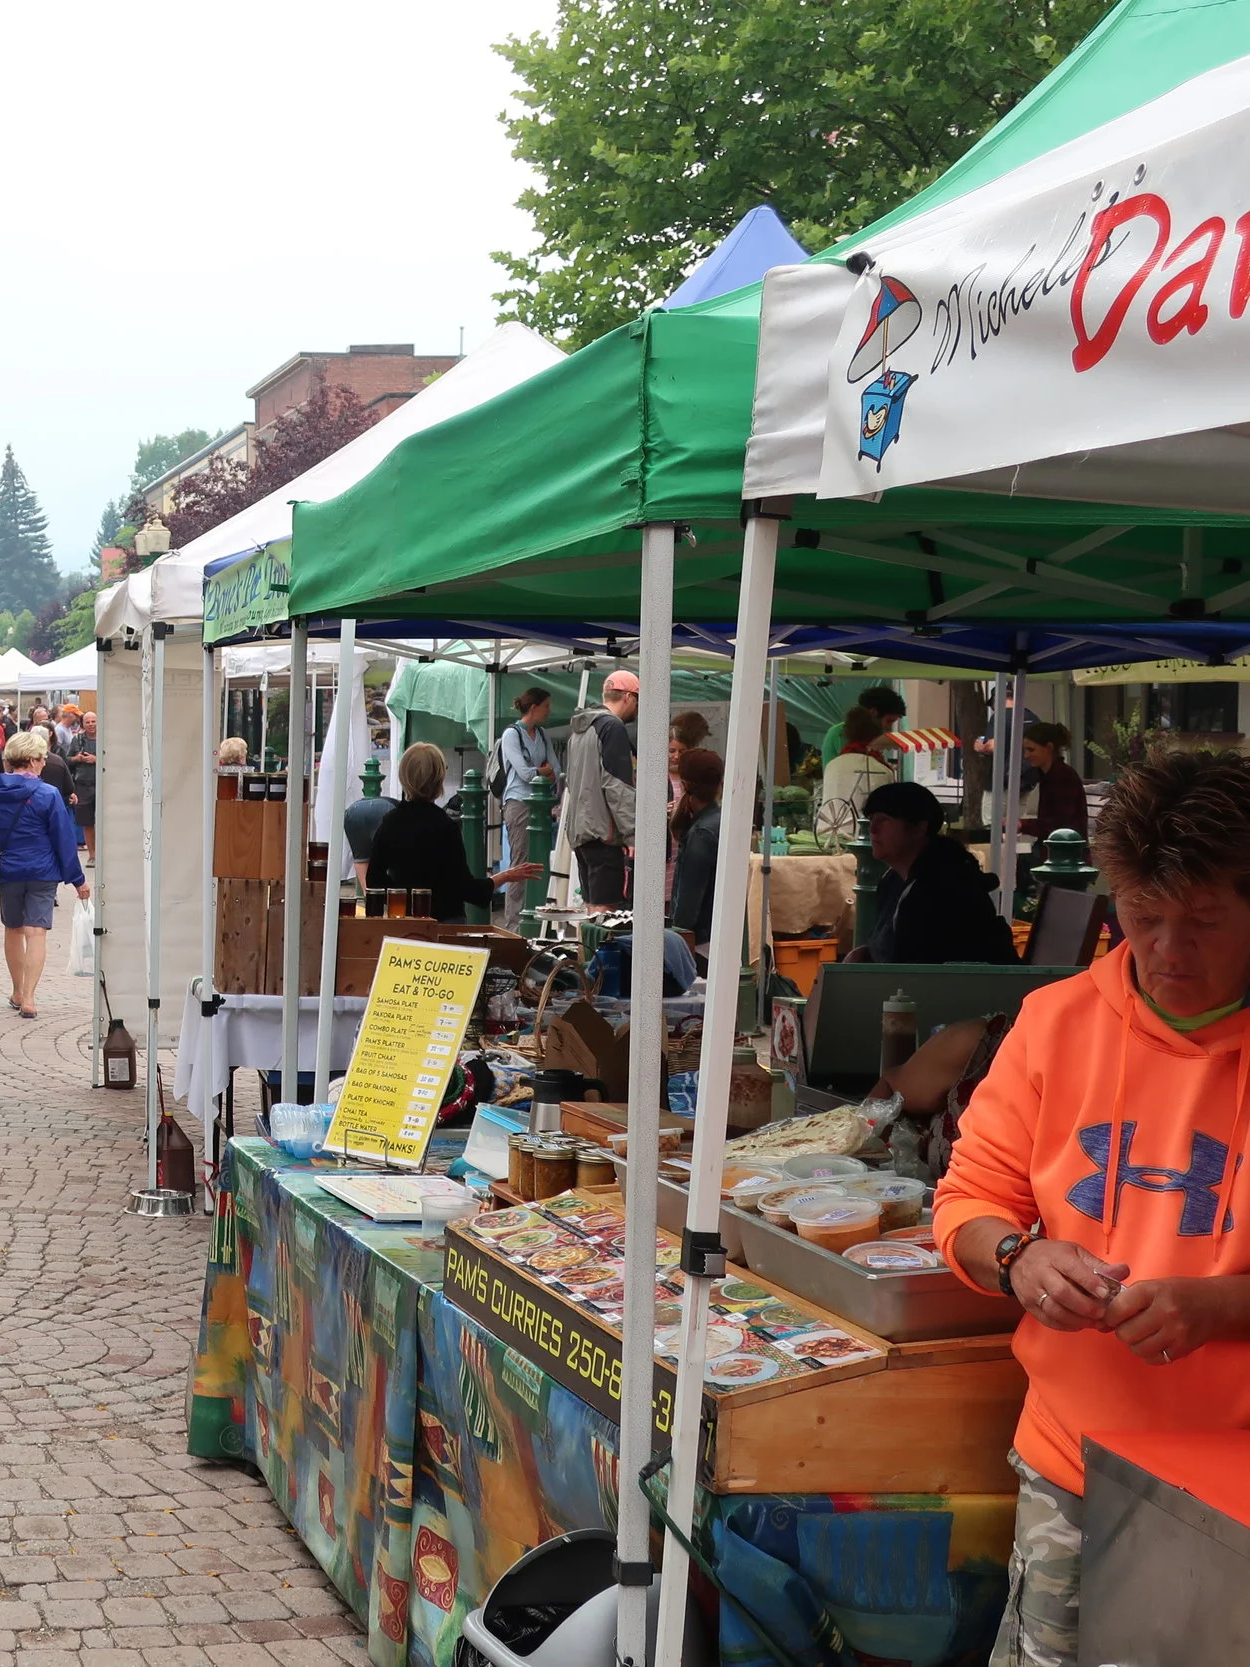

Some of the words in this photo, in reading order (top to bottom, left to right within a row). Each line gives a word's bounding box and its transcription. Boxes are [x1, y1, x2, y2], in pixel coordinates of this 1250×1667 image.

[389, 956, 422, 970] PAM'S
[424, 960, 474, 976] CURRIES
[412, 974, 442, 986] MENU
[393, 984, 411, 994] EAT
[412, 986, 419, 996] &
[422, 987, 454, 1000] TO-GO
[377, 997, 400, 1006] SAMOSA
[401, 1000, 418, 1008] PLATE
[373, 1011, 395, 1020] PAKORA
[396, 1013, 413, 1022] PLATE
[369, 1024, 390, 1033] COMBO
[390, 1027, 407, 1035] PLATE
[365, 1037, 382, 1045] PAM'S
[382, 1039, 405, 1048] PLATTER
[361, 1050, 376, 1059] FRUIT
[377, 1052, 396, 1061] CHAAT
[381, 1071, 407, 1080] SAMOSAS
[352, 1080, 363, 1088] BAG
[372, 1084, 397, 1093] PAKORAS
[347, 1094, 364, 1102] PLATE
[373, 1099, 396, 1107] KHICHRI
[343, 1107, 358, 1115] CHAI
[338, 1120, 359, 1129] BOTTLE
[360, 1124, 377, 1132] WATER
[447, 1248, 488, 1304] PAM'S
[491, 1280, 563, 1358] CURRIES
